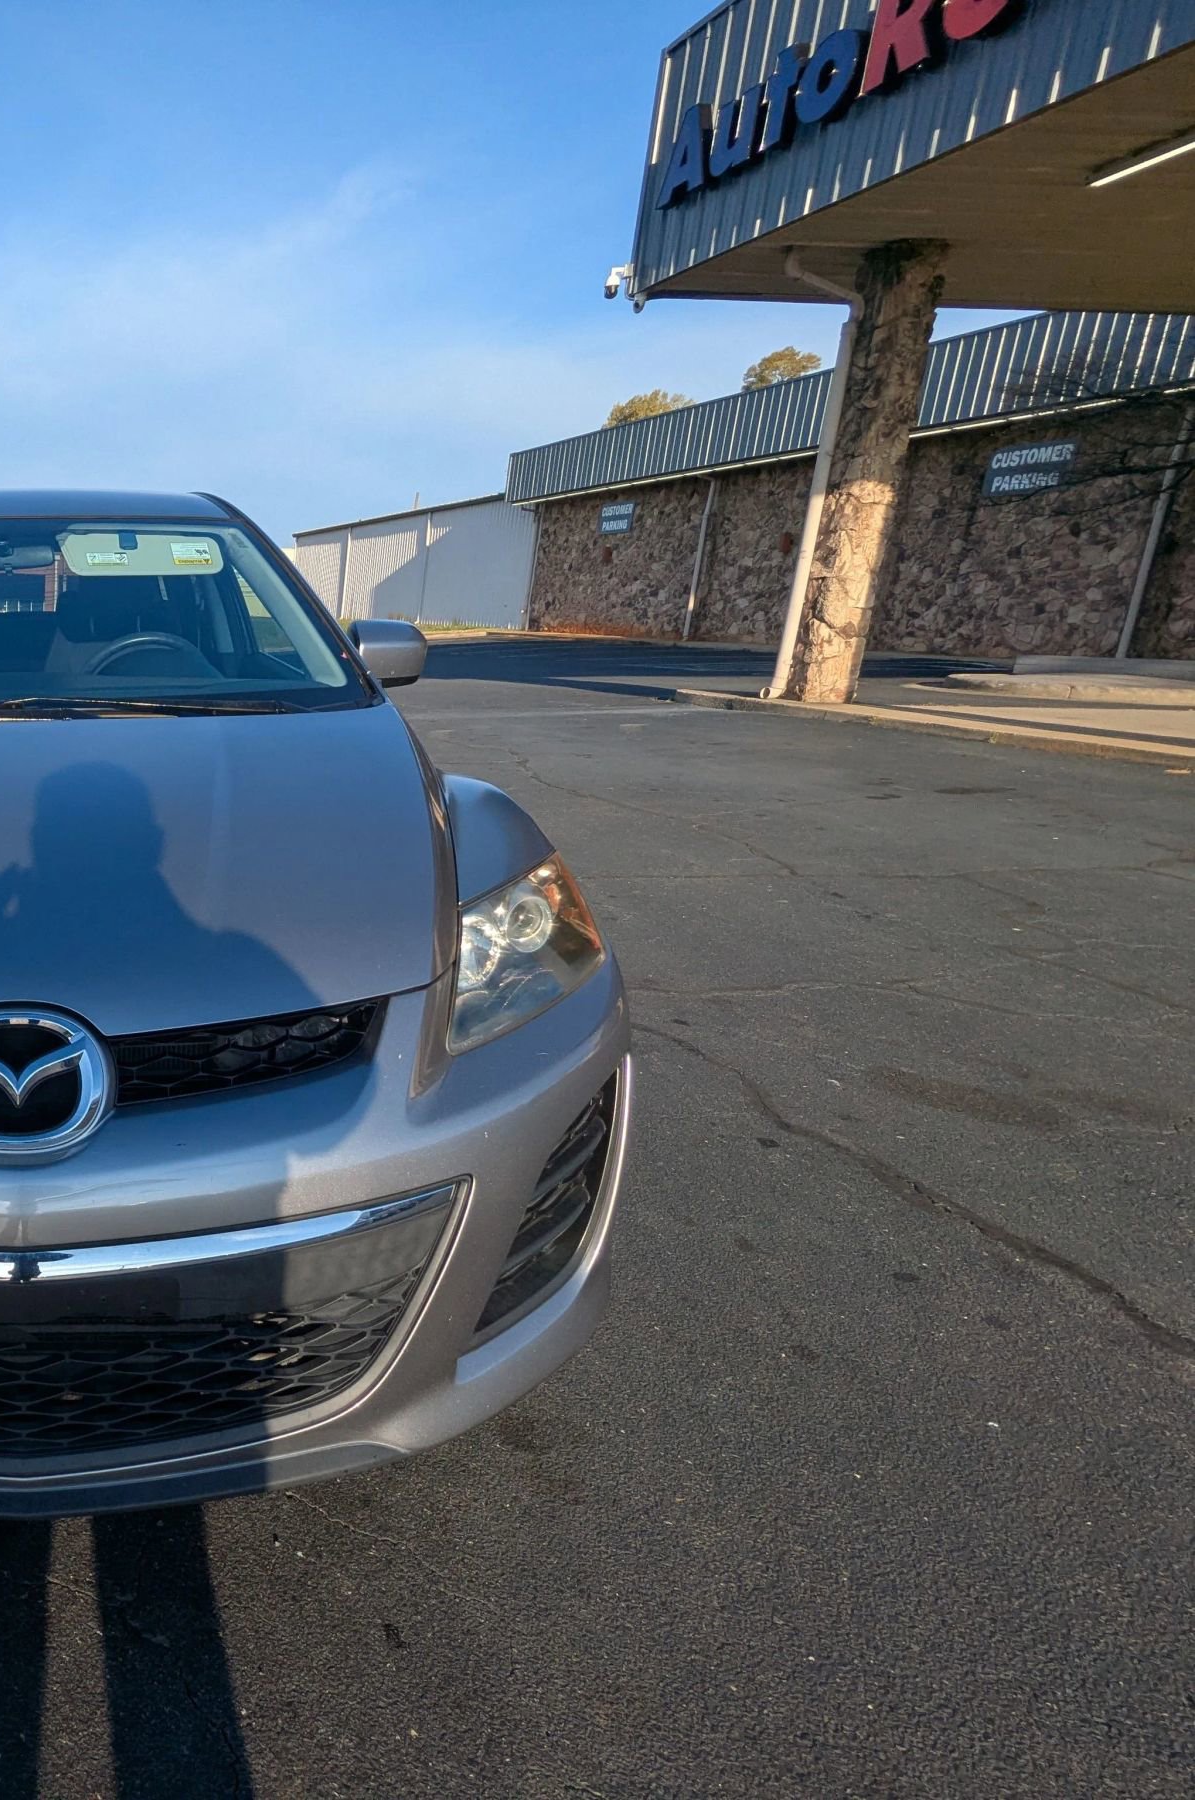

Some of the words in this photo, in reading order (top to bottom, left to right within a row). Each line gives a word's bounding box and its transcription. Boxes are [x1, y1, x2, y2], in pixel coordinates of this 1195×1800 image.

[991, 443, 1077, 469] CUSTOMER
[990, 472, 1060, 493] PARKING
[601, 503, 634, 517] CUSTOMER
[601, 519, 628, 531] PARKING
